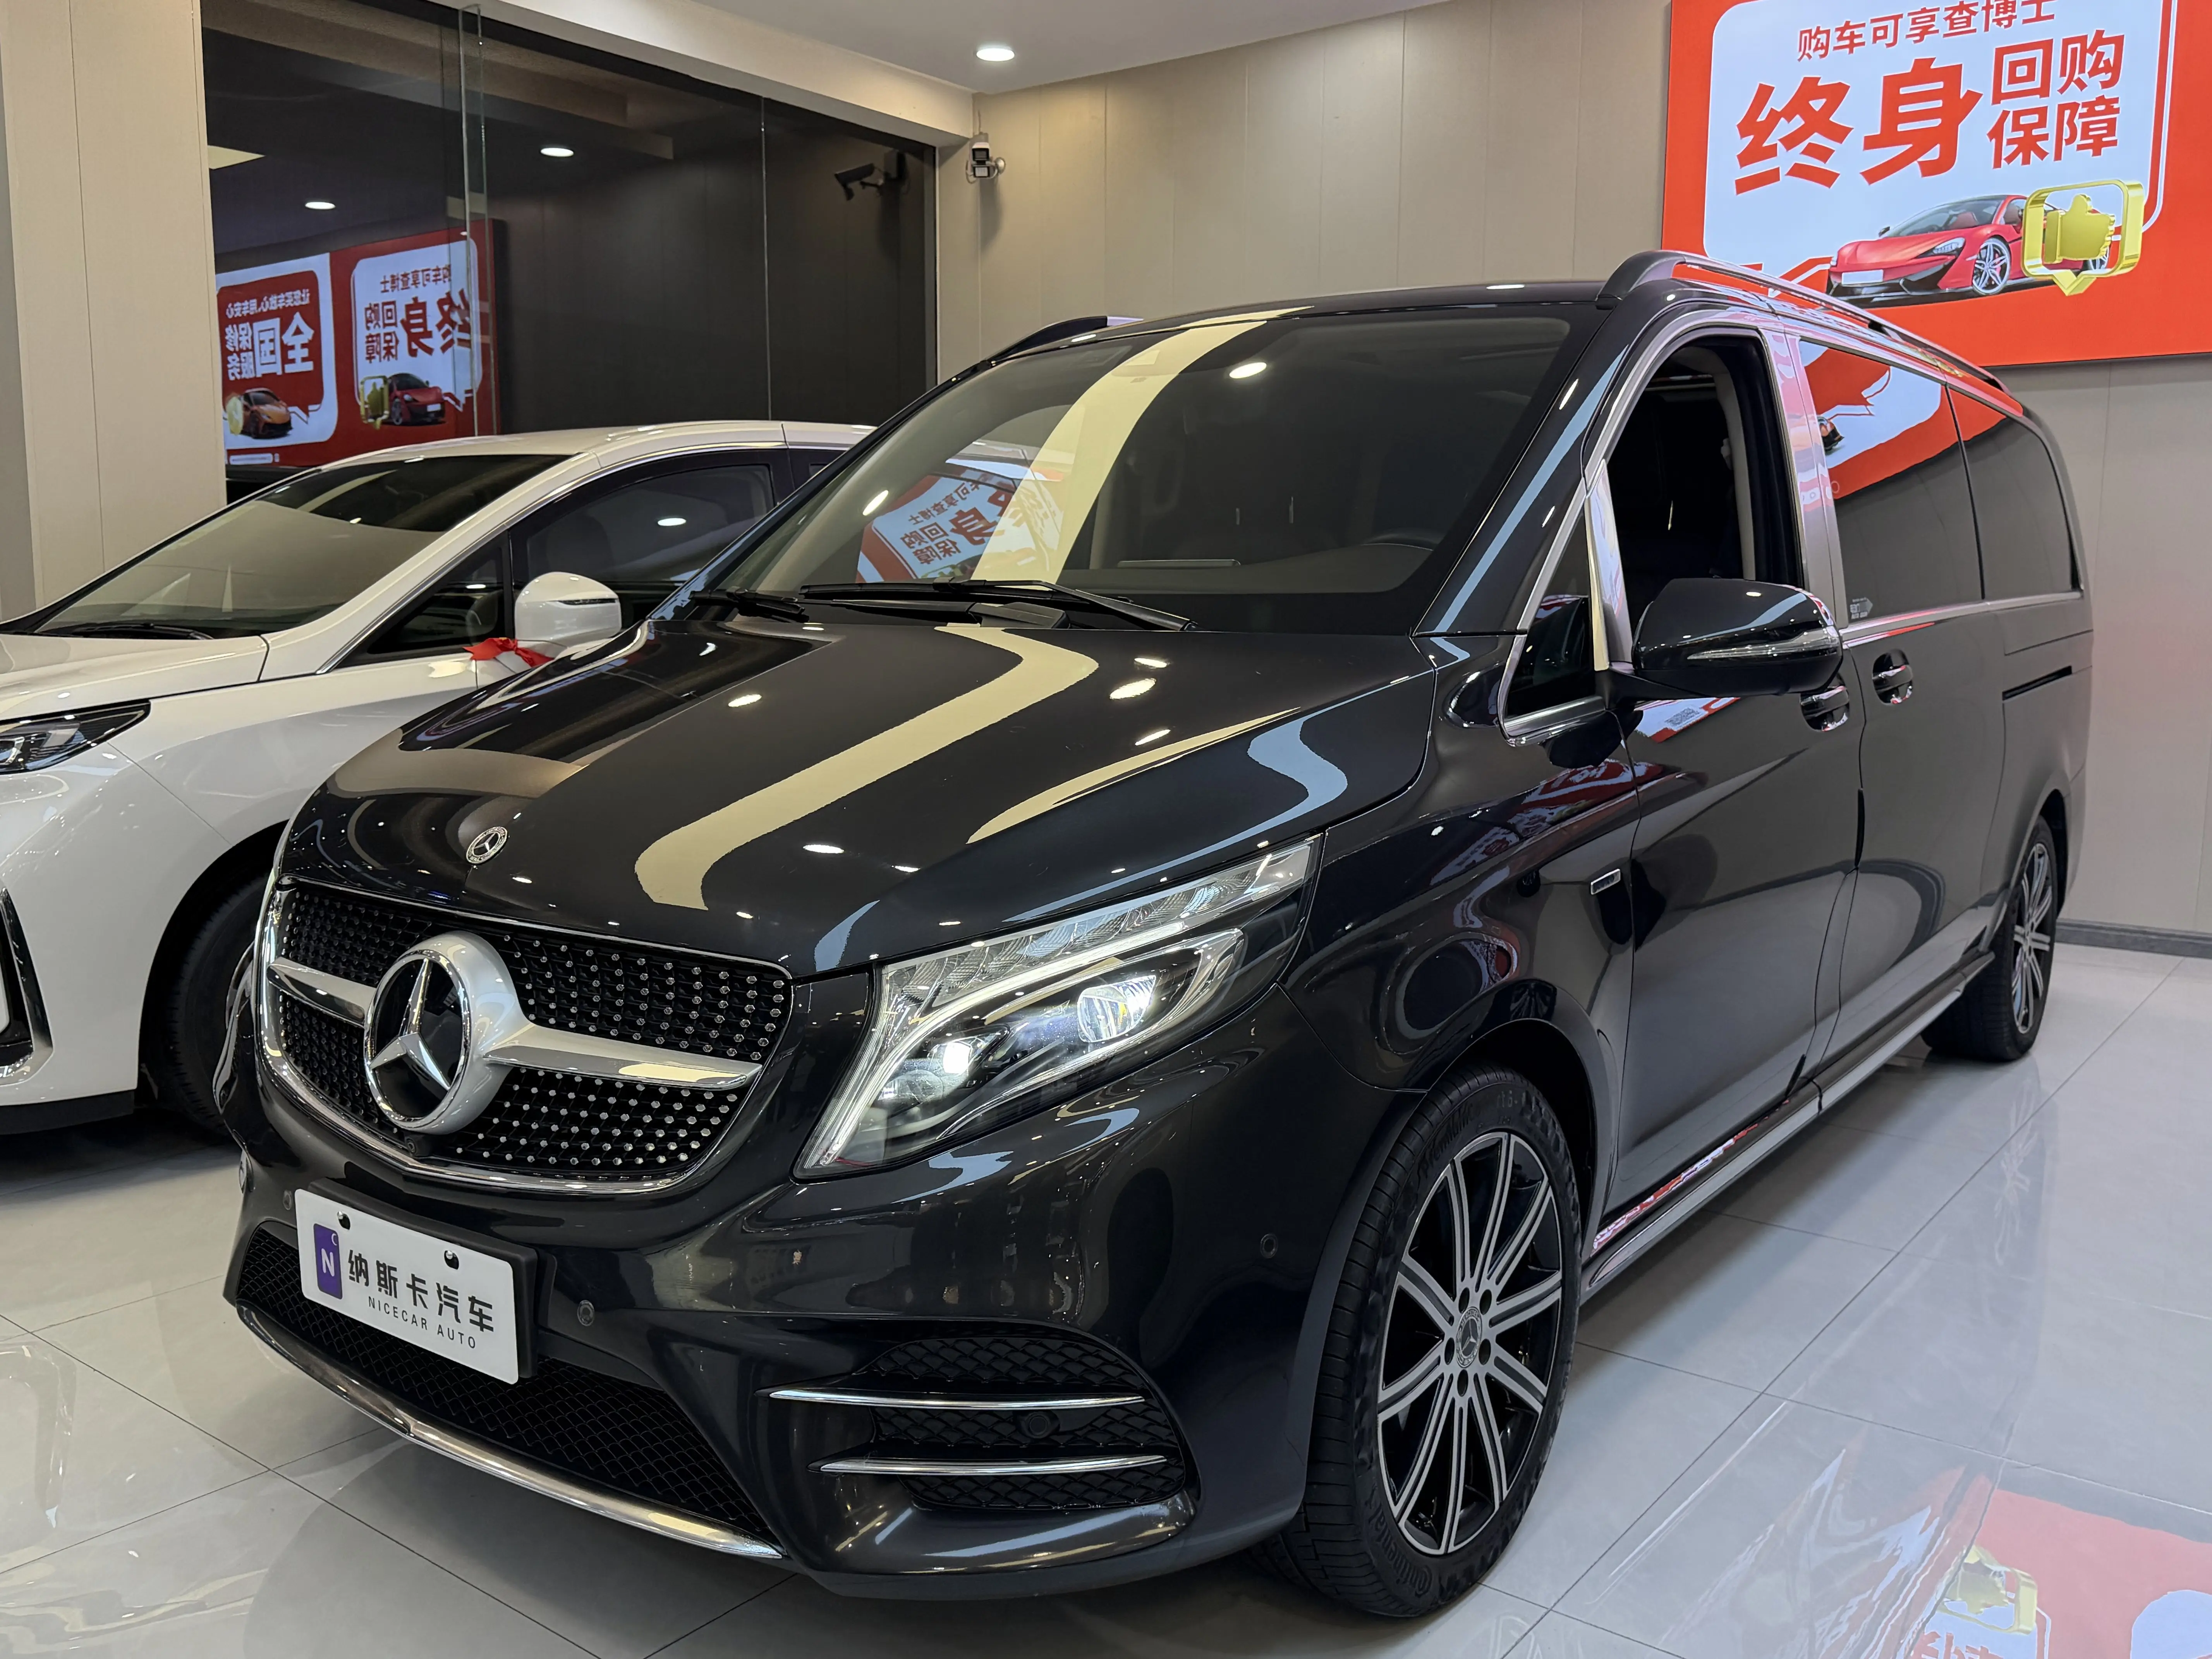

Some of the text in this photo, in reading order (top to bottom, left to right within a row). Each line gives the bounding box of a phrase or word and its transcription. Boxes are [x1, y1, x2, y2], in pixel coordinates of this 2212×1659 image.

[1797, 0, 2055, 62] 购车可享查博士
[1991, 29, 2125, 106] 回购
[1734, 57, 1983, 196] 终身
[1987, 95, 2121, 170] 保障
[348, 1249, 494, 1333] 纳斯卡汽车
[368, 1295, 476, 1349] NICECAR AUTO
